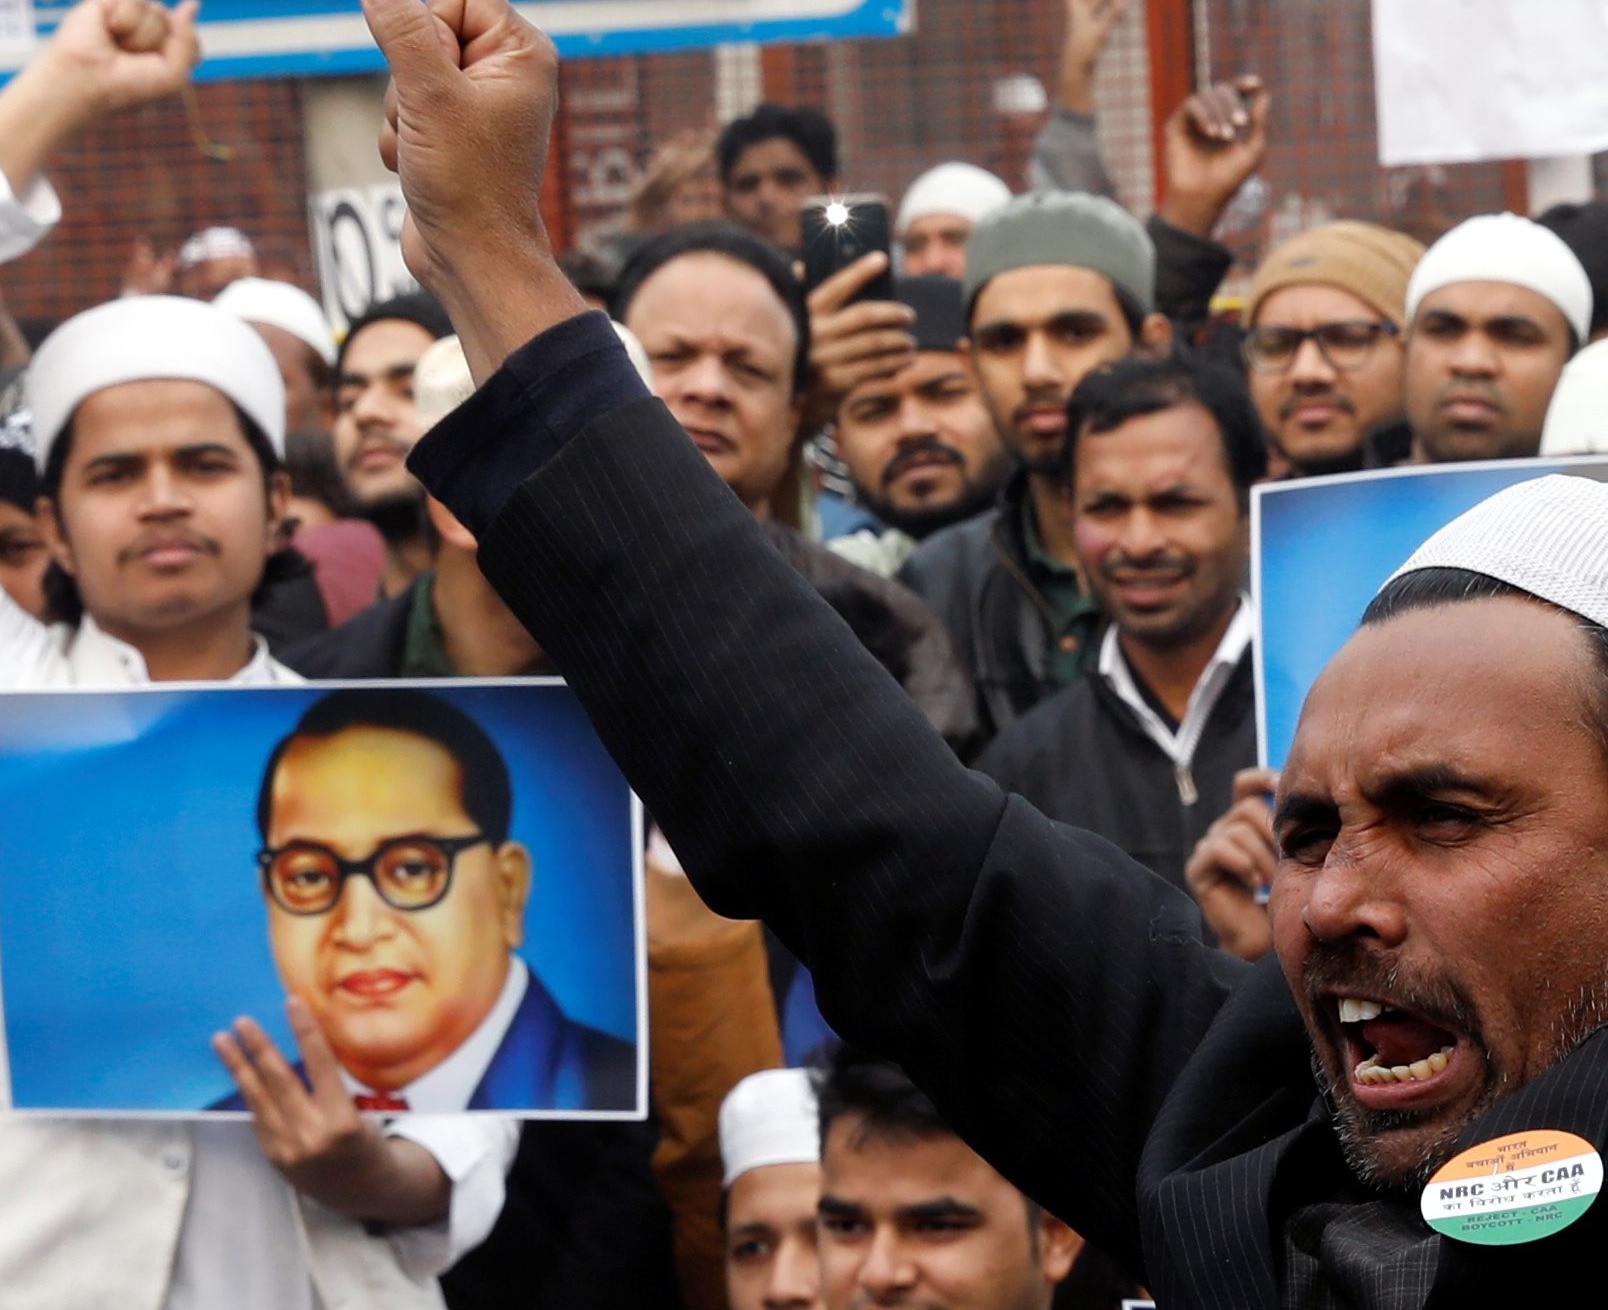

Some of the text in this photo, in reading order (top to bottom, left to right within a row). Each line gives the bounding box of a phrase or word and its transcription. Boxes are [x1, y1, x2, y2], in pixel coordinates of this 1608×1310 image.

[1497, 1140, 1528, 1153] भारत
[1439, 1163, 1585, 1200] NRC और CAA
[1461, 1218, 1523, 1231] BOYCOTT
[1535, 1211, 1563, 1223] NRC
[1466, 1210, 1519, 1223] REJECT
[1530, 1204, 1558, 1216] CAA
